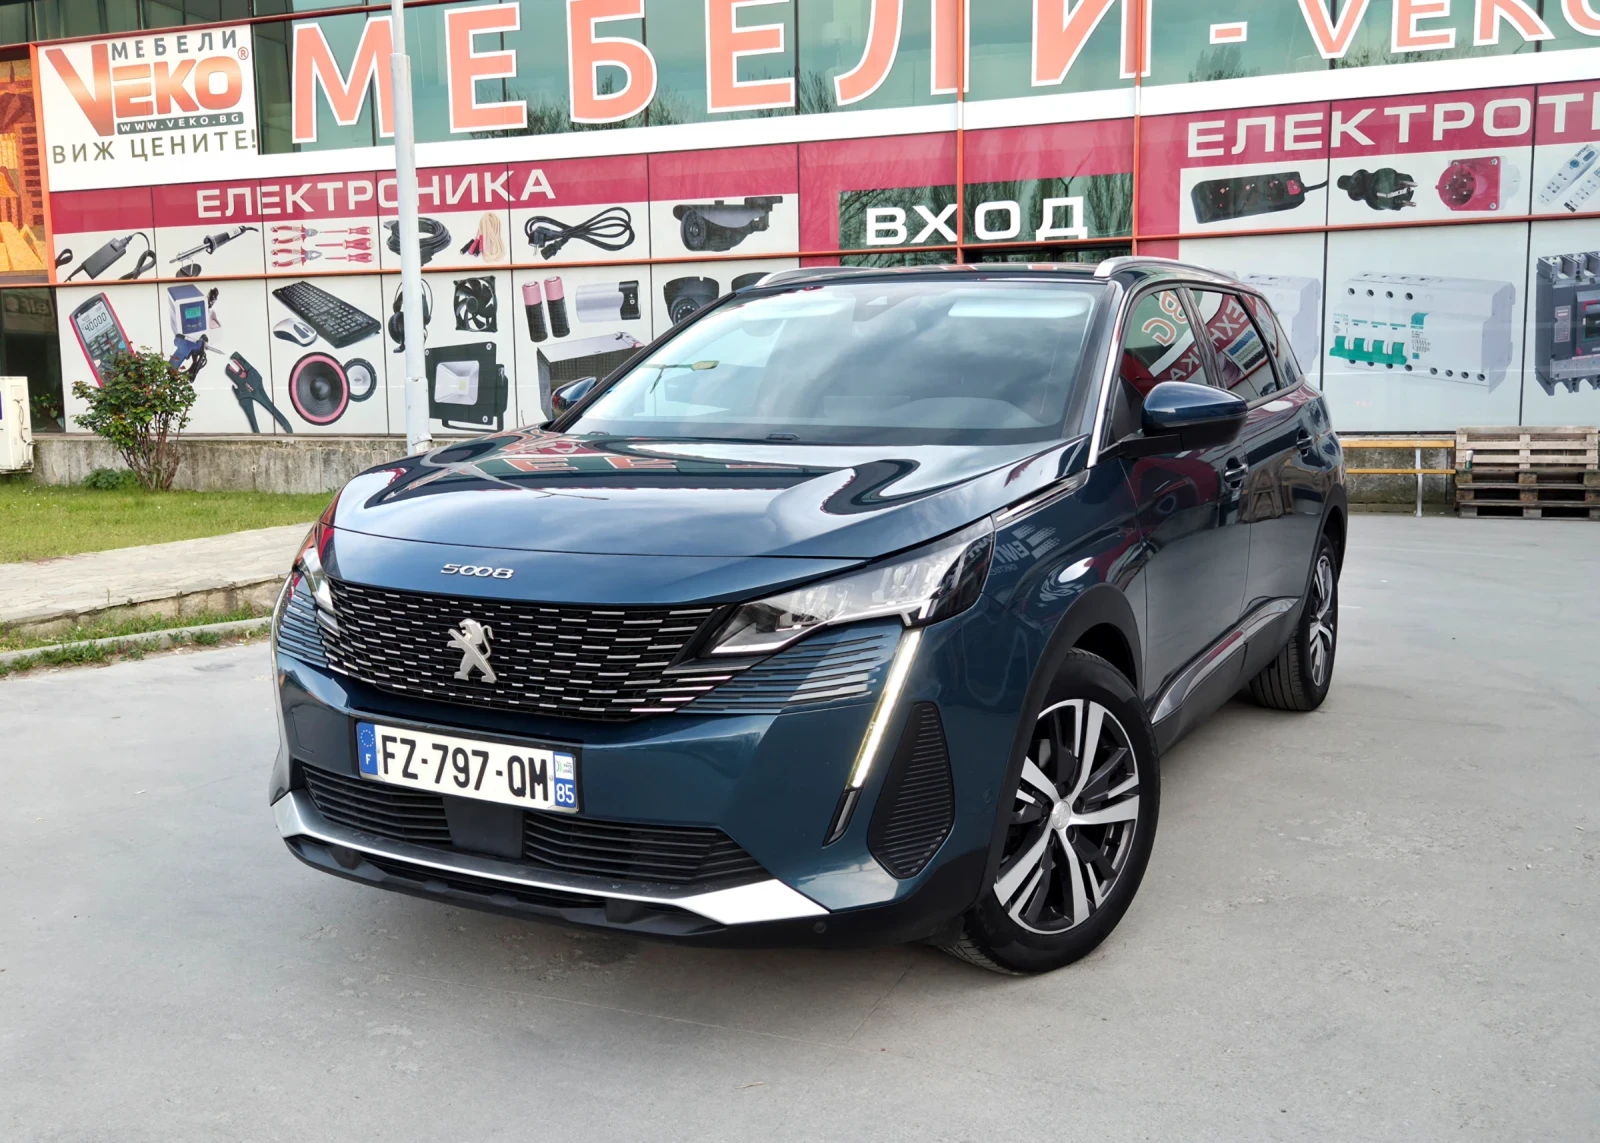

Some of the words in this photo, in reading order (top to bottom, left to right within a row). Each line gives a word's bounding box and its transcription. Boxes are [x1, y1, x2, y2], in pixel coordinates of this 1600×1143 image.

[111, 29, 238, 61] МЕБЕЛИ
[45, 43, 243, 137] VEKO
[292, 0, 1152, 143] МЕБЕЛИ
[1299, 0, 1600, 59] VEK
[120, 113, 240, 133] WWW.VEKO.BG
[1187, 92, 1600, 158] ЕЛЕКТРОТ
[52, 140, 115, 164] ВИЖ
[130, 129, 257, 162] ЦЕНИТЕ!
[196, 168, 557, 219] ЕЛЕКТРОНИКА
[866, 196, 1088, 246] ВХОД
[440, 563, 515, 580] 5008
[365, 753, 371, 765] F
[381, 734, 549, 802] FZ-797-QM
[556, 782, 575, 804] 85
